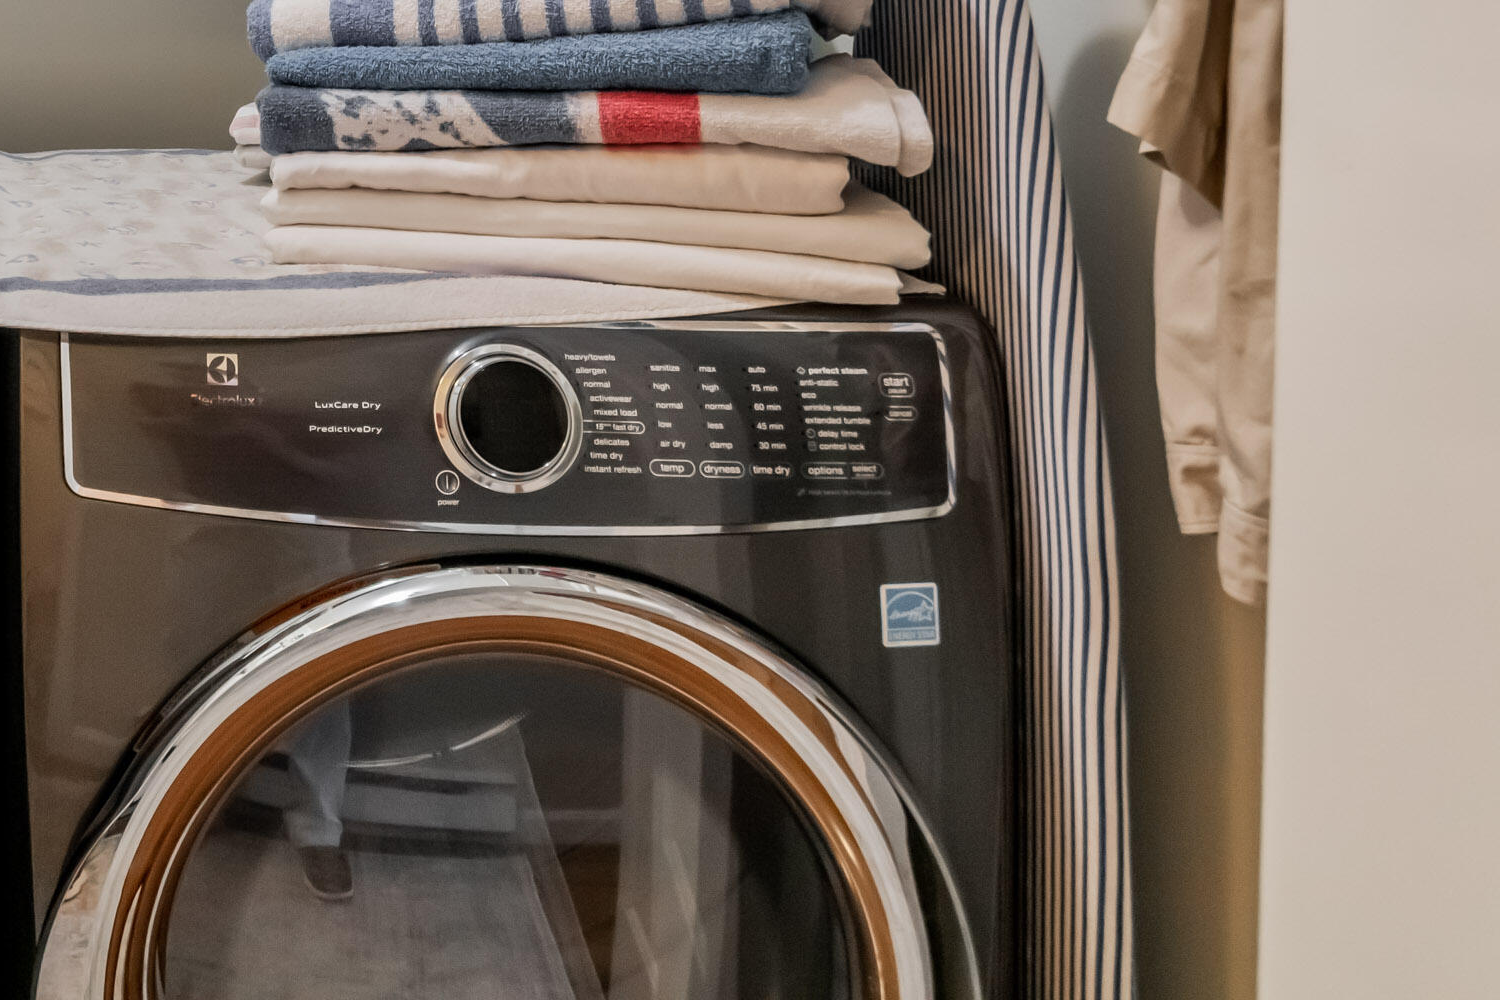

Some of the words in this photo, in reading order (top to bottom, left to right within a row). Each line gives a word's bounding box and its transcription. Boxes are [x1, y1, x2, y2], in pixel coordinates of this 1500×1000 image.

[575, 367, 607, 375] allergen
[883, 377, 910, 387] start
[653, 382, 670, 392] high
[702, 383, 719, 392] high
[314, 401, 359, 409] LuxCare
[361, 401, 381, 411] Dry
[704, 402, 732, 410] normal
[309, 424, 383, 434] PredictiveDry
[627, 424, 640, 432] dry
[593, 438, 630, 446] delicates
[672, 440, 686, 449] dry
[610, 452, 623, 461] dry
[584, 465, 611, 473] instant
[614, 465, 642, 473] refresh
[660, 463, 685, 473] temp
[704, 464, 741, 475] dryness
[753, 466, 773, 474] time
[775, 466, 790, 477] dry
